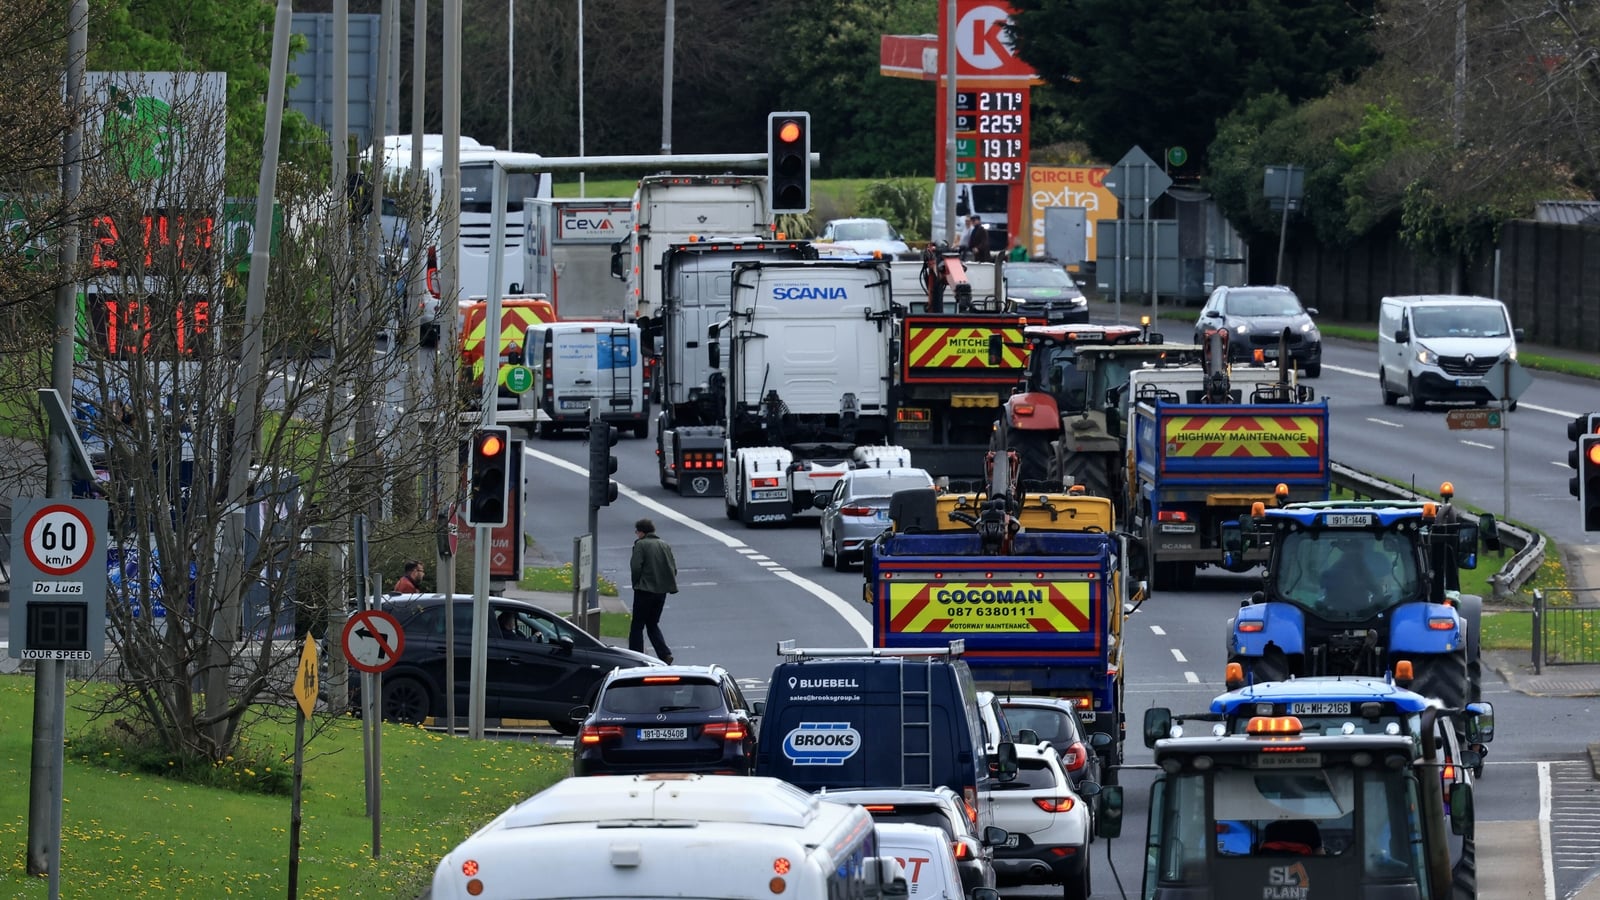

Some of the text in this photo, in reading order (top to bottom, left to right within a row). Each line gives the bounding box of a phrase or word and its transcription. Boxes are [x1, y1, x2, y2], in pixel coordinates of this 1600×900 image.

[958, 94, 967, 103] D
[980, 92, 1021, 110] 217.9
[958, 117, 967, 125] D
[980, 115, 1021, 133] 225.9
[983, 140, 1021, 157] 191.9
[983, 162, 1021, 180] 199.9
[1031, 171, 1083, 183] CIRCLE
[1032, 186, 1098, 211] extra
[773, 287, 847, 300] SCANIA
[1177, 433, 1306, 441] HIGHWAY MAINTENANCE
[753, 514, 787, 522] SCANIA
[42, 522, 76, 551] 60
[45, 555, 72, 566] km/h
[35, 583, 81, 592] Do Luas
[937, 590, 1042, 604] COCOMAN
[947, 607, 1034, 616] 087 6380111
[23, 650, 90, 659] YOUR SPEED
[800, 679, 859, 688] BLUEBELL
[644, 730, 684, 738] 181-D-49408
[794, 735, 854, 745] BROOKS
[1270, 866, 1296, 884] SL
[1264, 887, 1308, 898] PLANT
